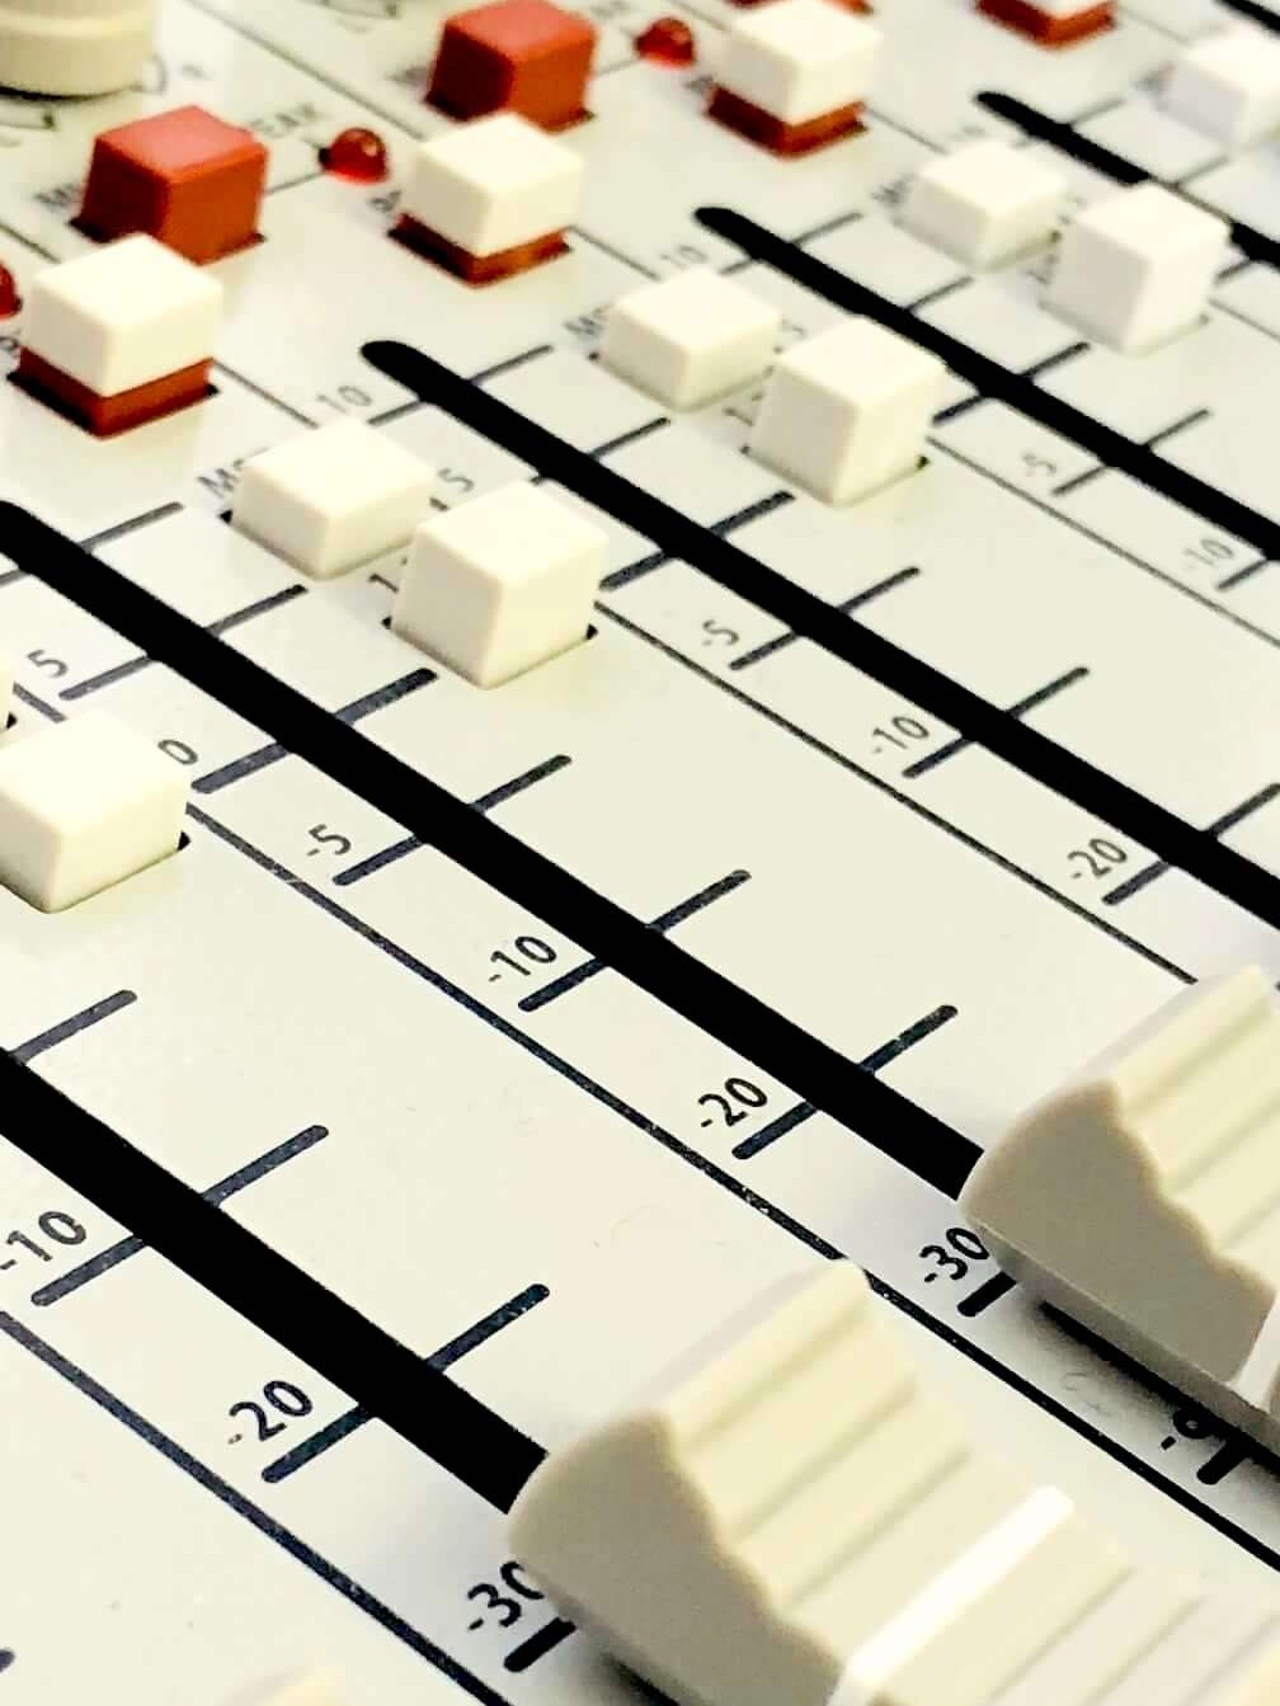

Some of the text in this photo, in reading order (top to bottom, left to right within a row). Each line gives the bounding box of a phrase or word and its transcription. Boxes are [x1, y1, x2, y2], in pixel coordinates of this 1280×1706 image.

[27, 648, 69, 679] 5
[157, 738, 198, 767] 0
[869, 715, 929, 755] -10
[306, 823, 352, 859] -5
[1067, 838, 1127, 882] -20
[486, 935, 556, 984] -10
[698, 1077, 767, 1132] -20
[0, 1209, 87, 1275] -10
[919, 1228, 990, 1283] -30
[227, 1380, 313, 1445] -20
